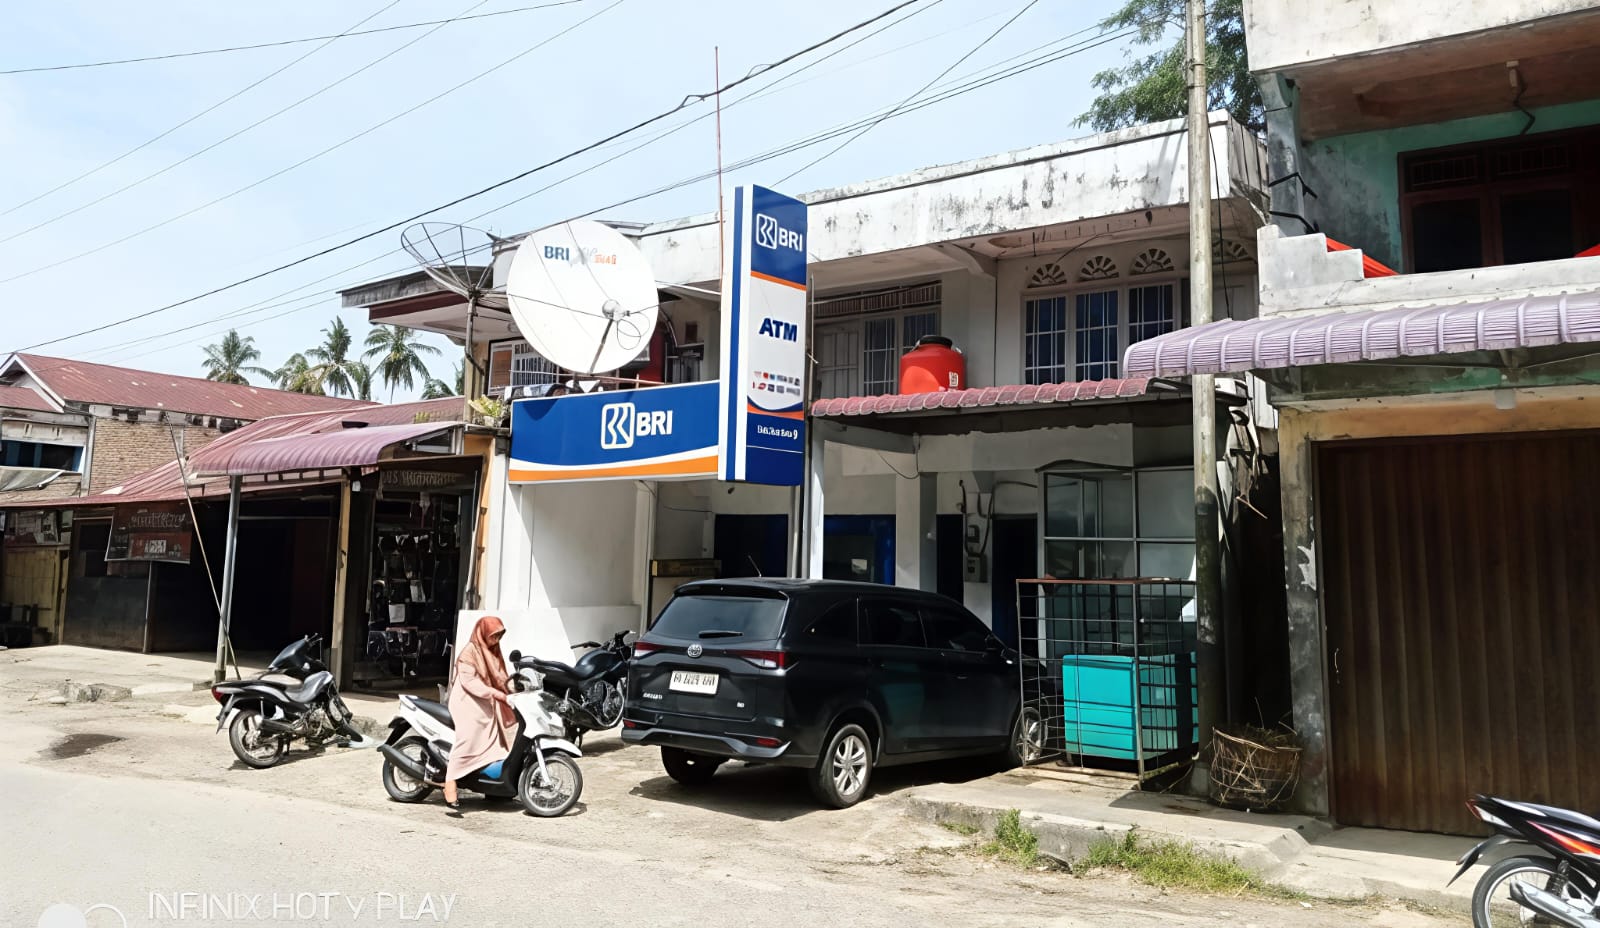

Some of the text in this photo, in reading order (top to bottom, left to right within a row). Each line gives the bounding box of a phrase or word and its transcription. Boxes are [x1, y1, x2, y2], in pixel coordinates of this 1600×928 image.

[779, 227, 803, 252] BRI
[544, 245, 570, 261] BRI
[758, 318, 798, 343] ATM
[636, 410, 673, 437] BRI
